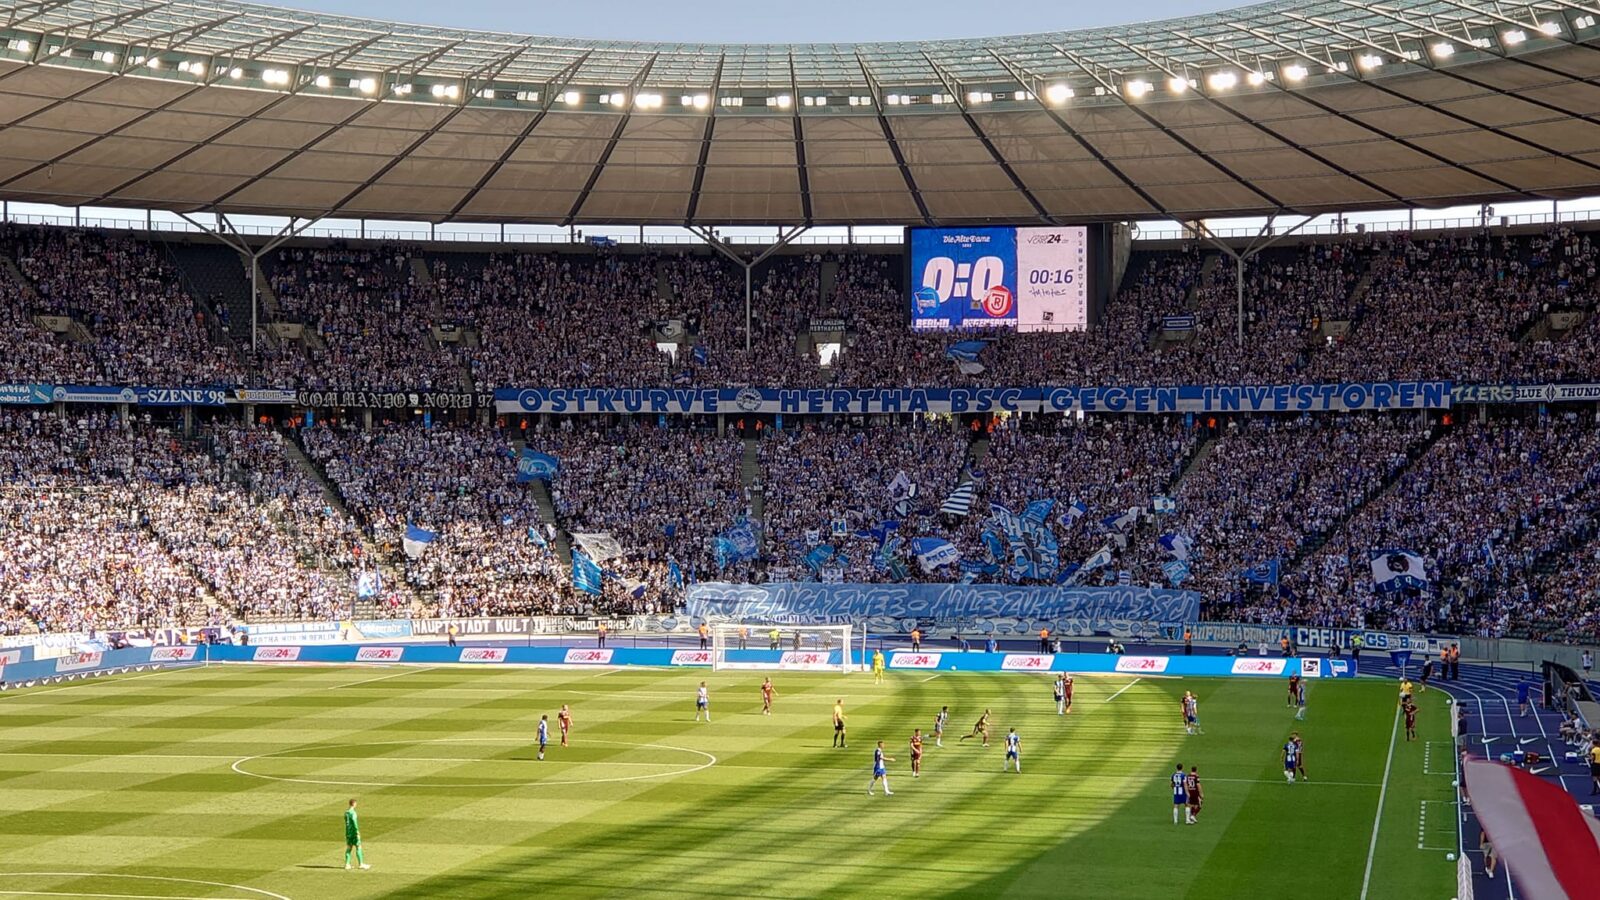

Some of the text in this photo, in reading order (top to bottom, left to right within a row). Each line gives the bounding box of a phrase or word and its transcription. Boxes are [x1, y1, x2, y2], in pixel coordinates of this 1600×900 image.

[1029, 269, 1074, 285] 00:16
[916, 318, 950, 328] BERLIN
[298, 391, 407, 409] COMMANDO
[424, 391, 472, 409] NORD
[477, 393, 494, 408] 97
[518, 389, 719, 412] OSTKURVE
[779, 388, 930, 412] HERTHA
[950, 388, 1022, 412] BSC
[1049, 387, 1179, 412] GEGEN
[1202, 382, 1444, 411] INVESTOREN
[1451, 385, 1515, 402] 71ERS
[1515, 388, 1543, 399] BLUE
[690, 586, 769, 618] TROTZ
[770, 581, 831, 617] LIGA
[825, 587, 908, 618] ZWEE
[495, 619, 530, 632] KULT
[1297, 628, 1345, 649] CREW
[1365, 633, 1388, 648] GS
